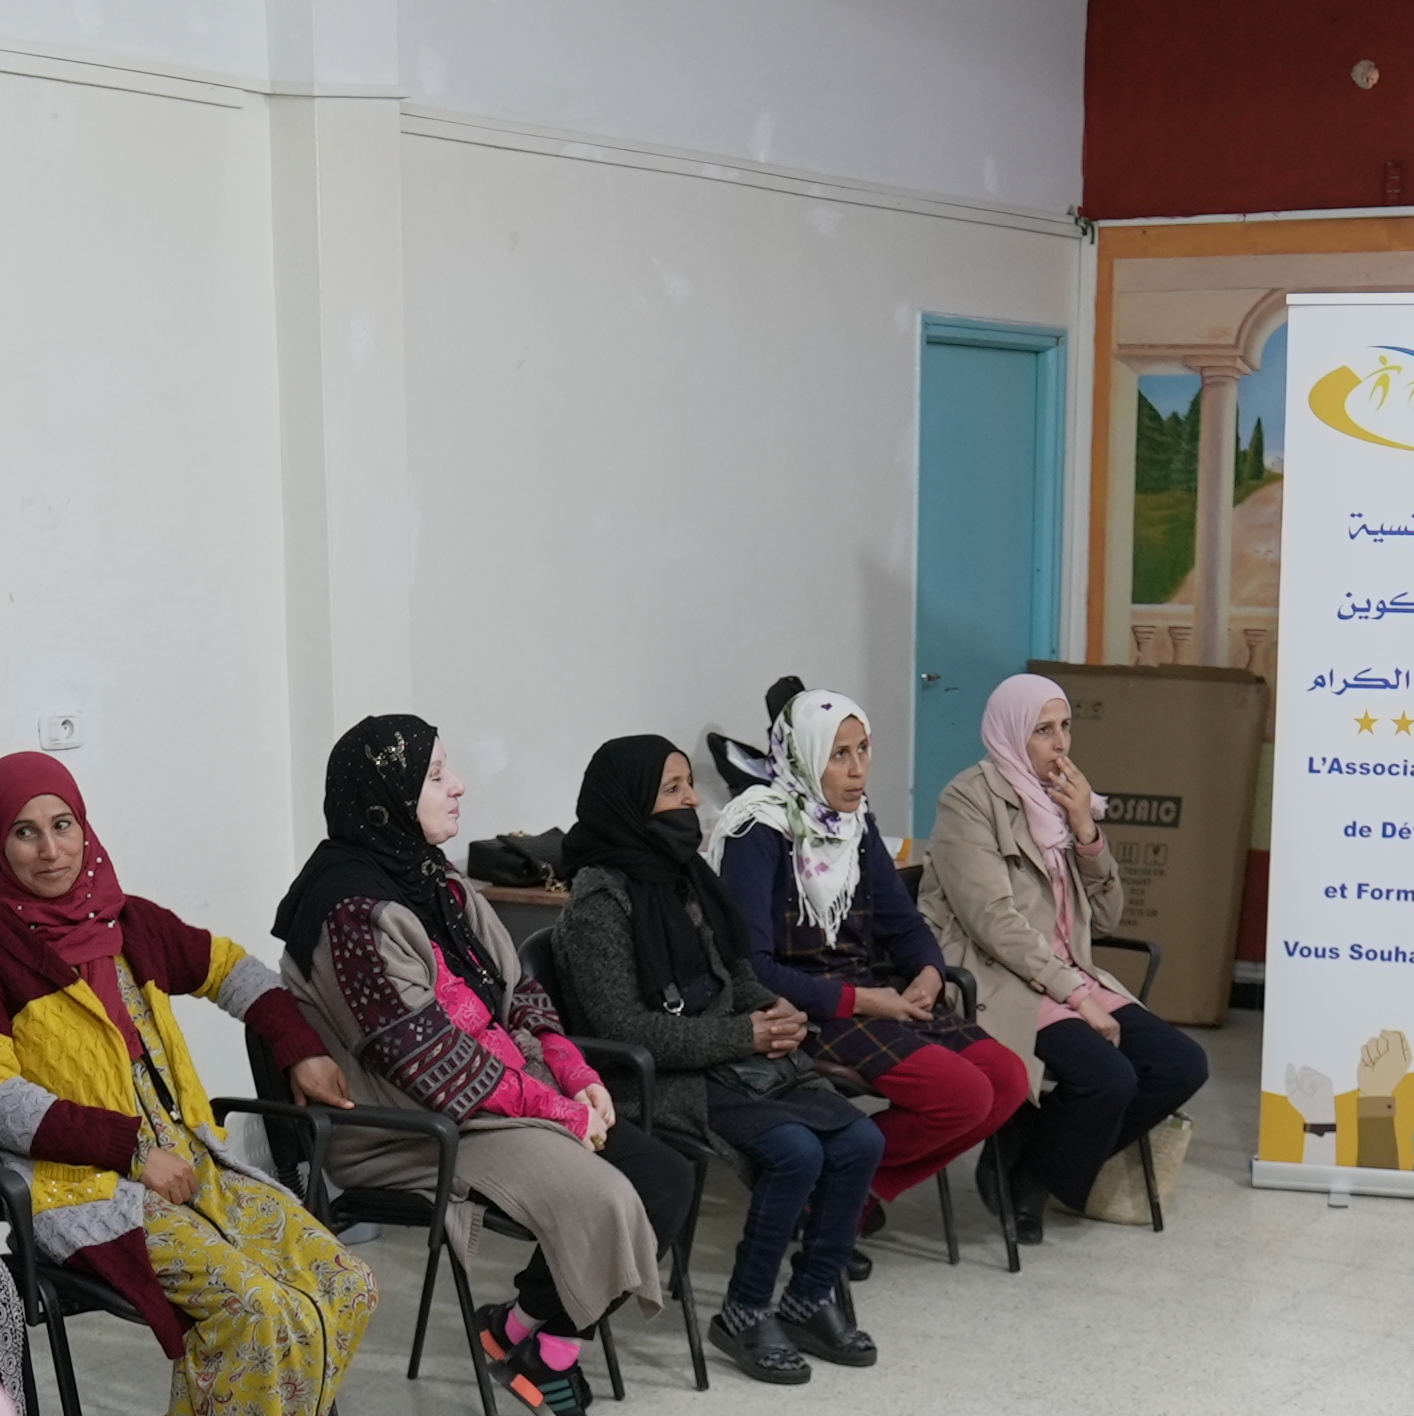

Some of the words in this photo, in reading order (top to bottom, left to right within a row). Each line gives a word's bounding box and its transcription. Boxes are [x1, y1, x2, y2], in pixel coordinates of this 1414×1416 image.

[1306, 667, 1410, 696] الكرام
[1107, 798, 1177, 823] OSAIC
[1343, 820, 1373, 839] de
[1323, 882, 1349, 900] et
[1282, 939, 1341, 961] Vous
